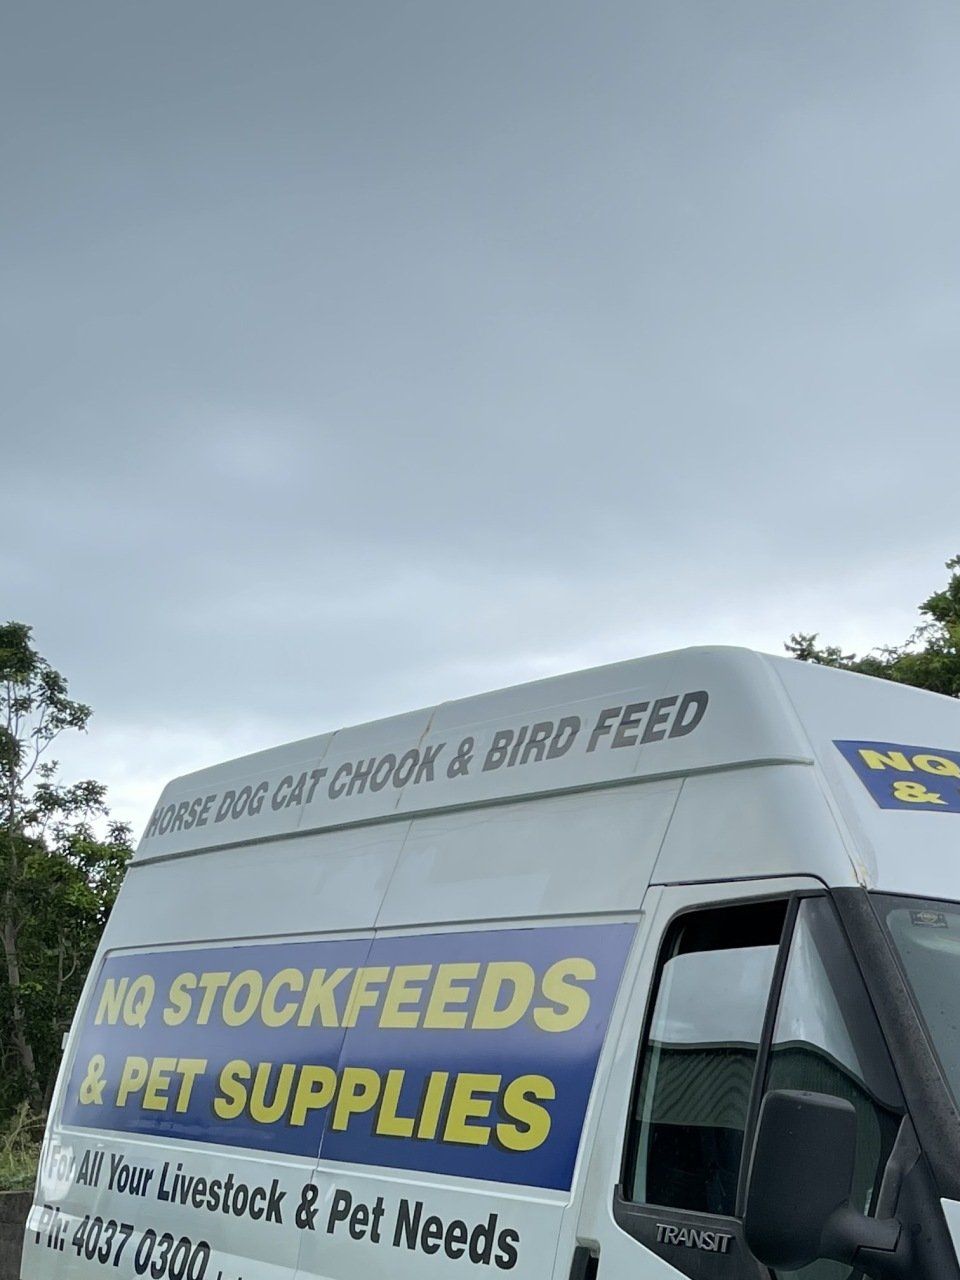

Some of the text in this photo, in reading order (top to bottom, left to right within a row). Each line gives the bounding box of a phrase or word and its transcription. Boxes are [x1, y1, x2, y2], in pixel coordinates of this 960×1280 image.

[144, 690, 710, 838] HORSE DOG CAT CHOOK & BIRD FEED
[892, 781, 949, 805] &
[94, 957, 597, 1033] NQ STOCKFEEDS
[78, 1054, 557, 1152] & PET SUPPLIES
[48, 1145, 520, 1270] For All Your Livestock & Pet Needs
[72, 1215, 134, 1267] 4037
[656, 1223, 732, 1253] TRANSIT
